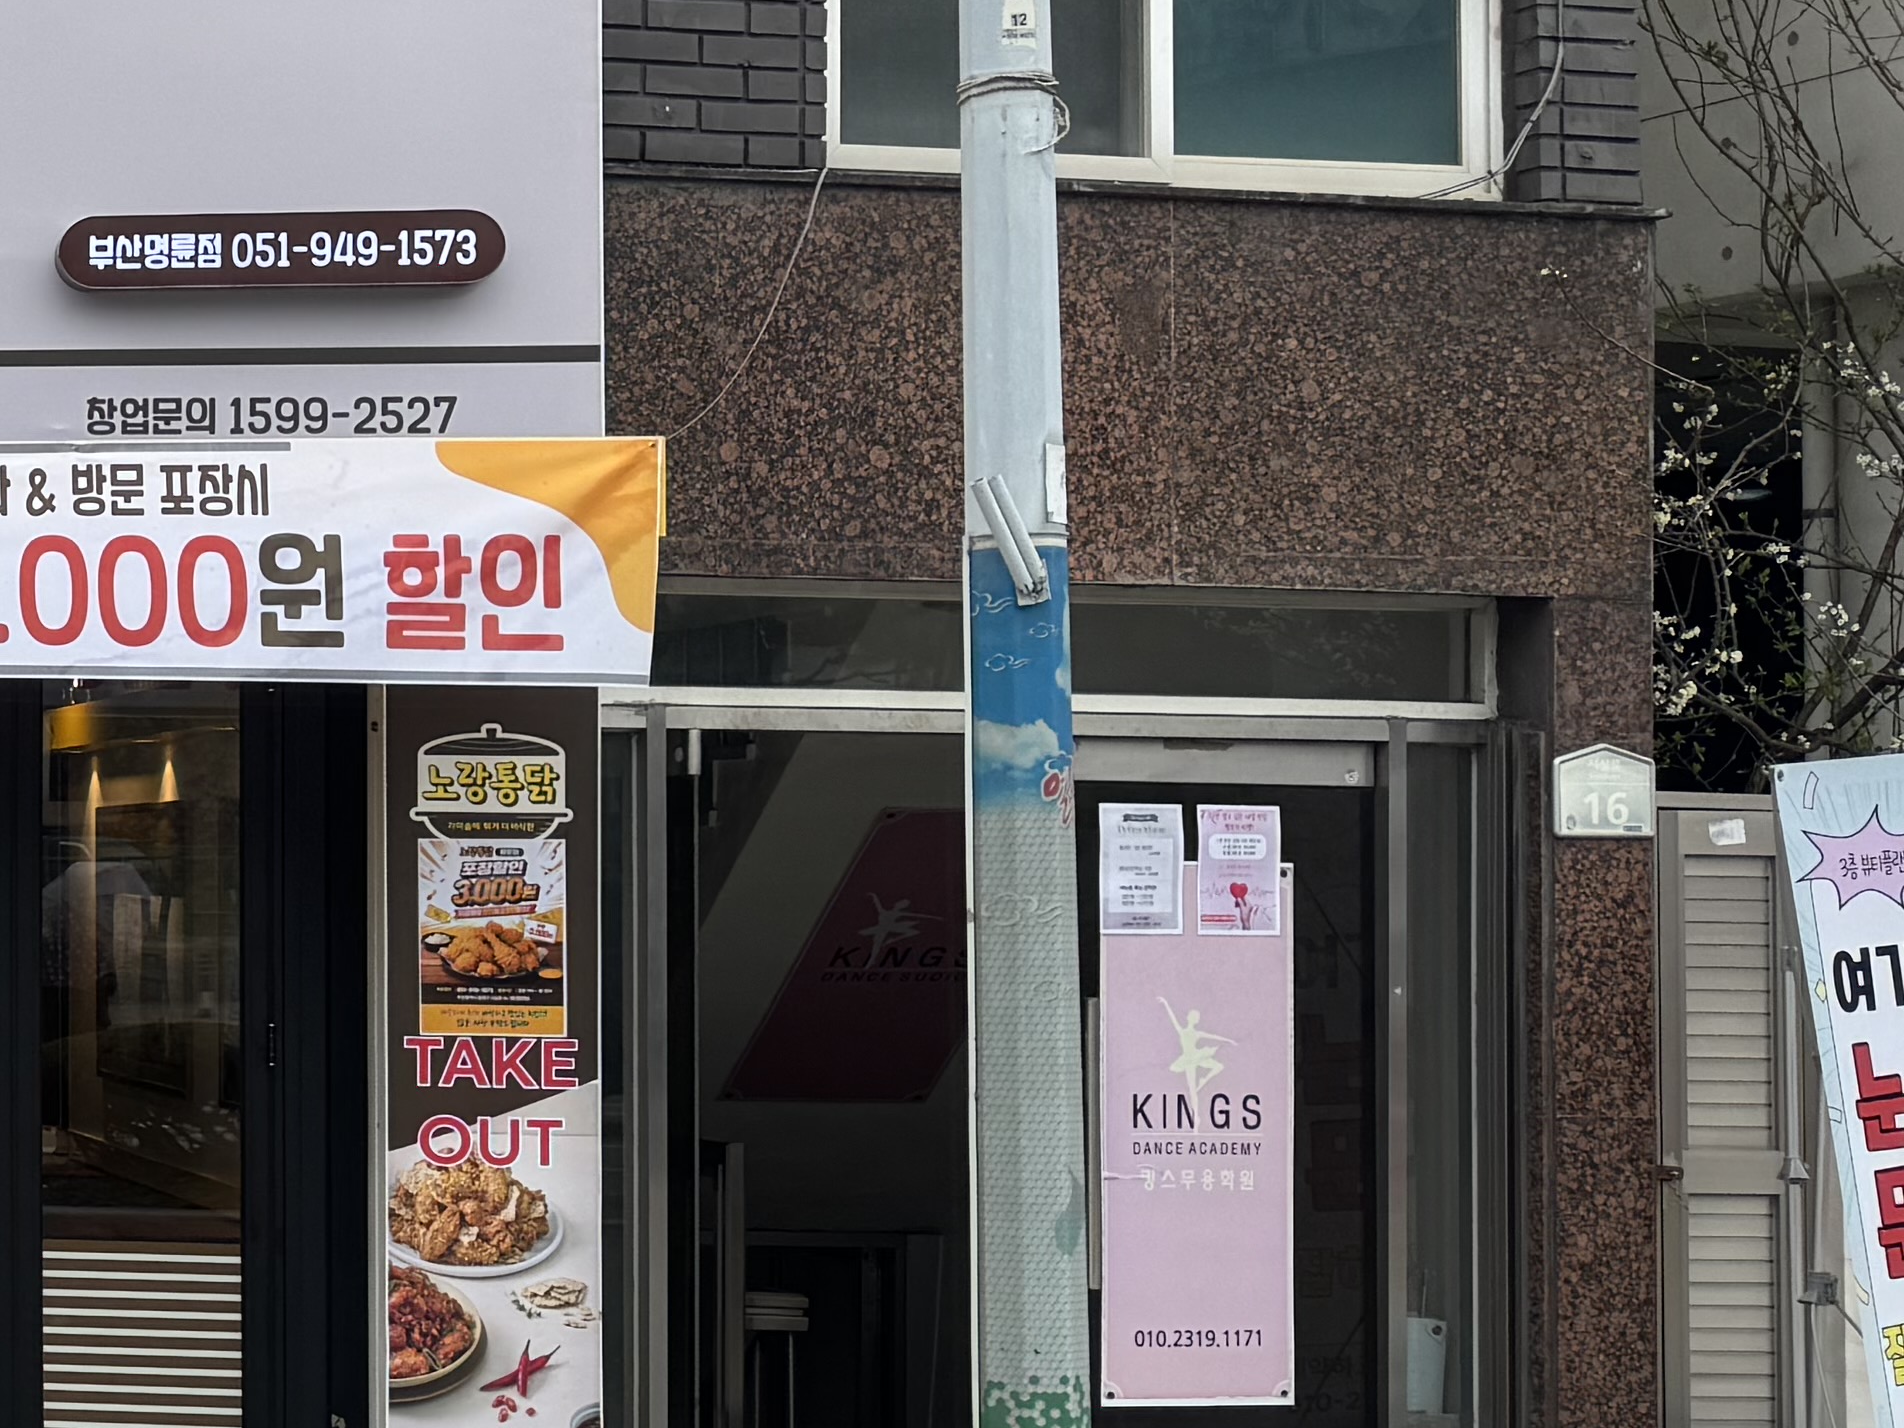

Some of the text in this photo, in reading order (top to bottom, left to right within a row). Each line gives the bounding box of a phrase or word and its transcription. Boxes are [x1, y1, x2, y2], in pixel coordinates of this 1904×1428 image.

[88, 229, 477, 270] 부산명륜점 051-949-1573
[86, 395, 458, 435] 창업문의 1599-2527
[27, 465, 57, 516] &
[71, 462, 144, 517] 방문
[159, 462, 271, 517] 포장시
[383, 532, 565, 652] 할인
[422, 761, 561, 806] 노랑통닭
[1583, 791, 1629, 826] 16
[1839, 852, 1858, 880] 3층
[404, 1037, 579, 1090] TAKE
[1133, 1093, 1261, 1130] KINGS
[418, 1115, 565, 1167] OUT
[1133, 1141, 1261, 1155] DANCE ACADEMY
[1134, 1329, 1263, 1349] 010.2319.1171
